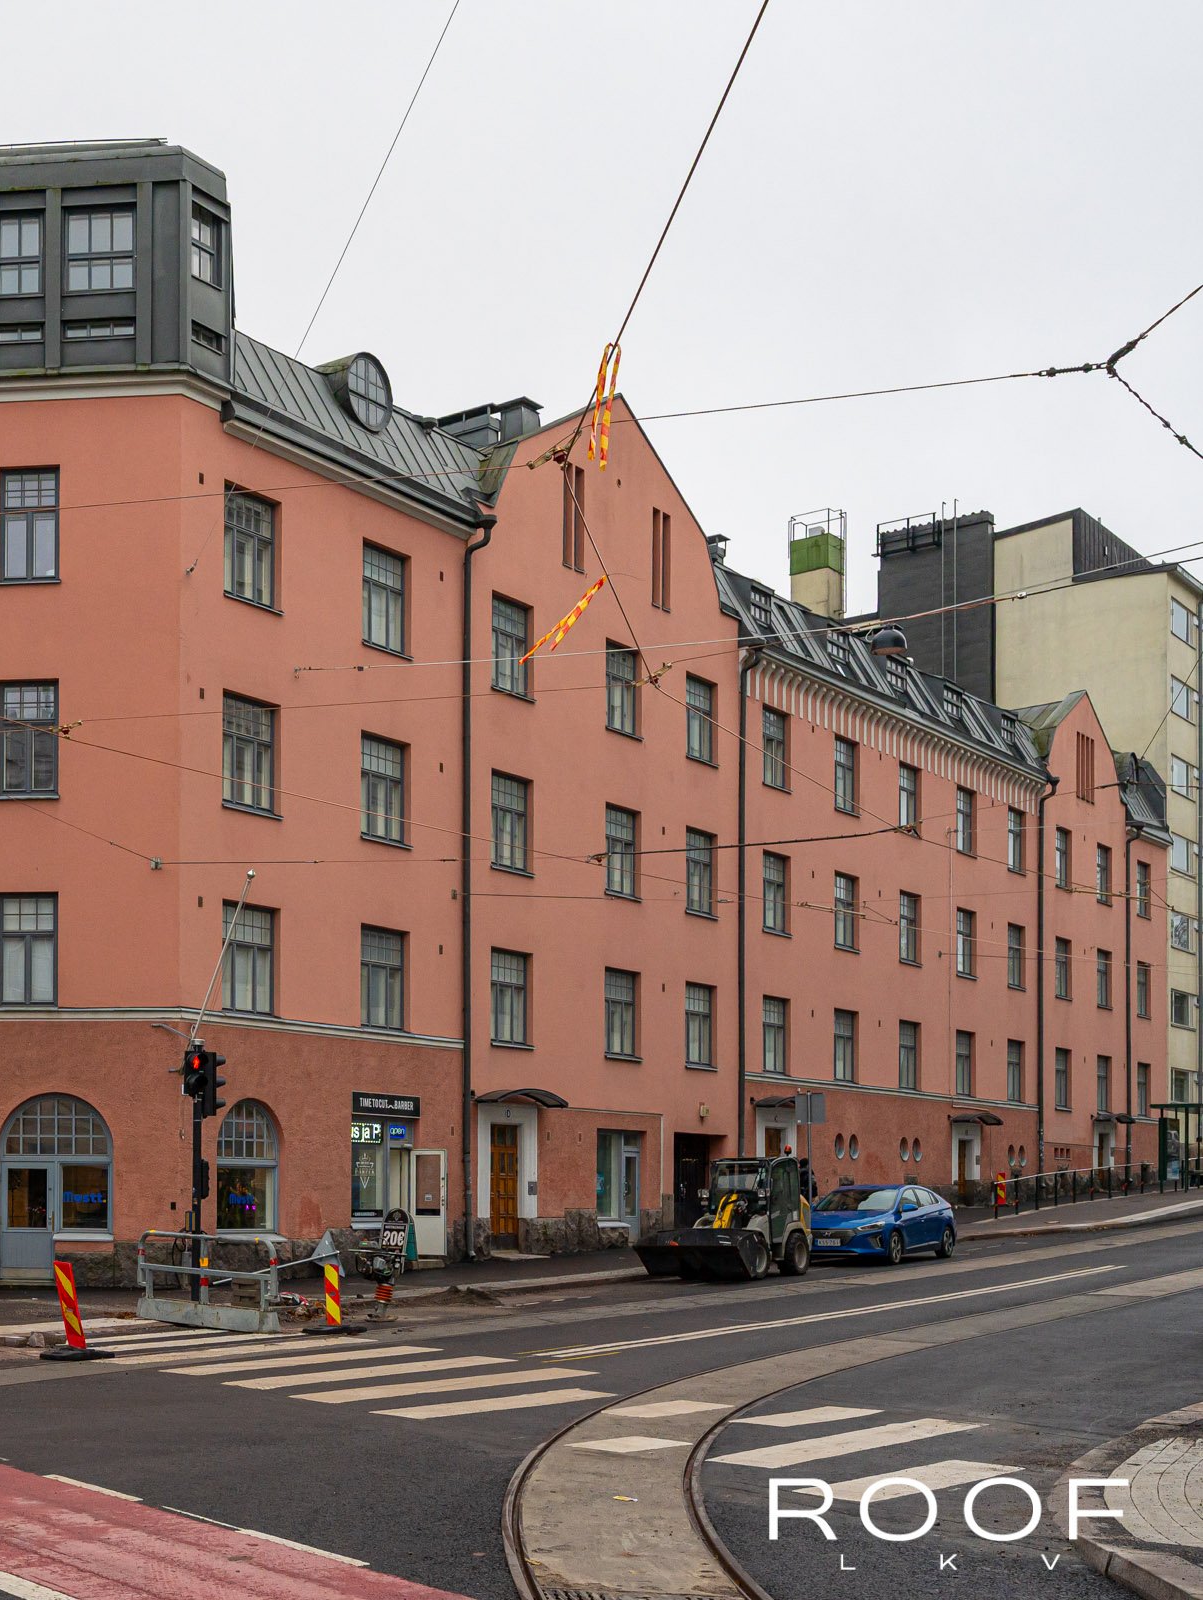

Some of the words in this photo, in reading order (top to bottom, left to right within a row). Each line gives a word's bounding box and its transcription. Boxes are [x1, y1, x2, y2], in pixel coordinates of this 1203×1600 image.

[394, 1100, 414, 1111] BARBER
[389, 1127, 406, 1136] open
[382, 1230, 405, 1247] 20€
